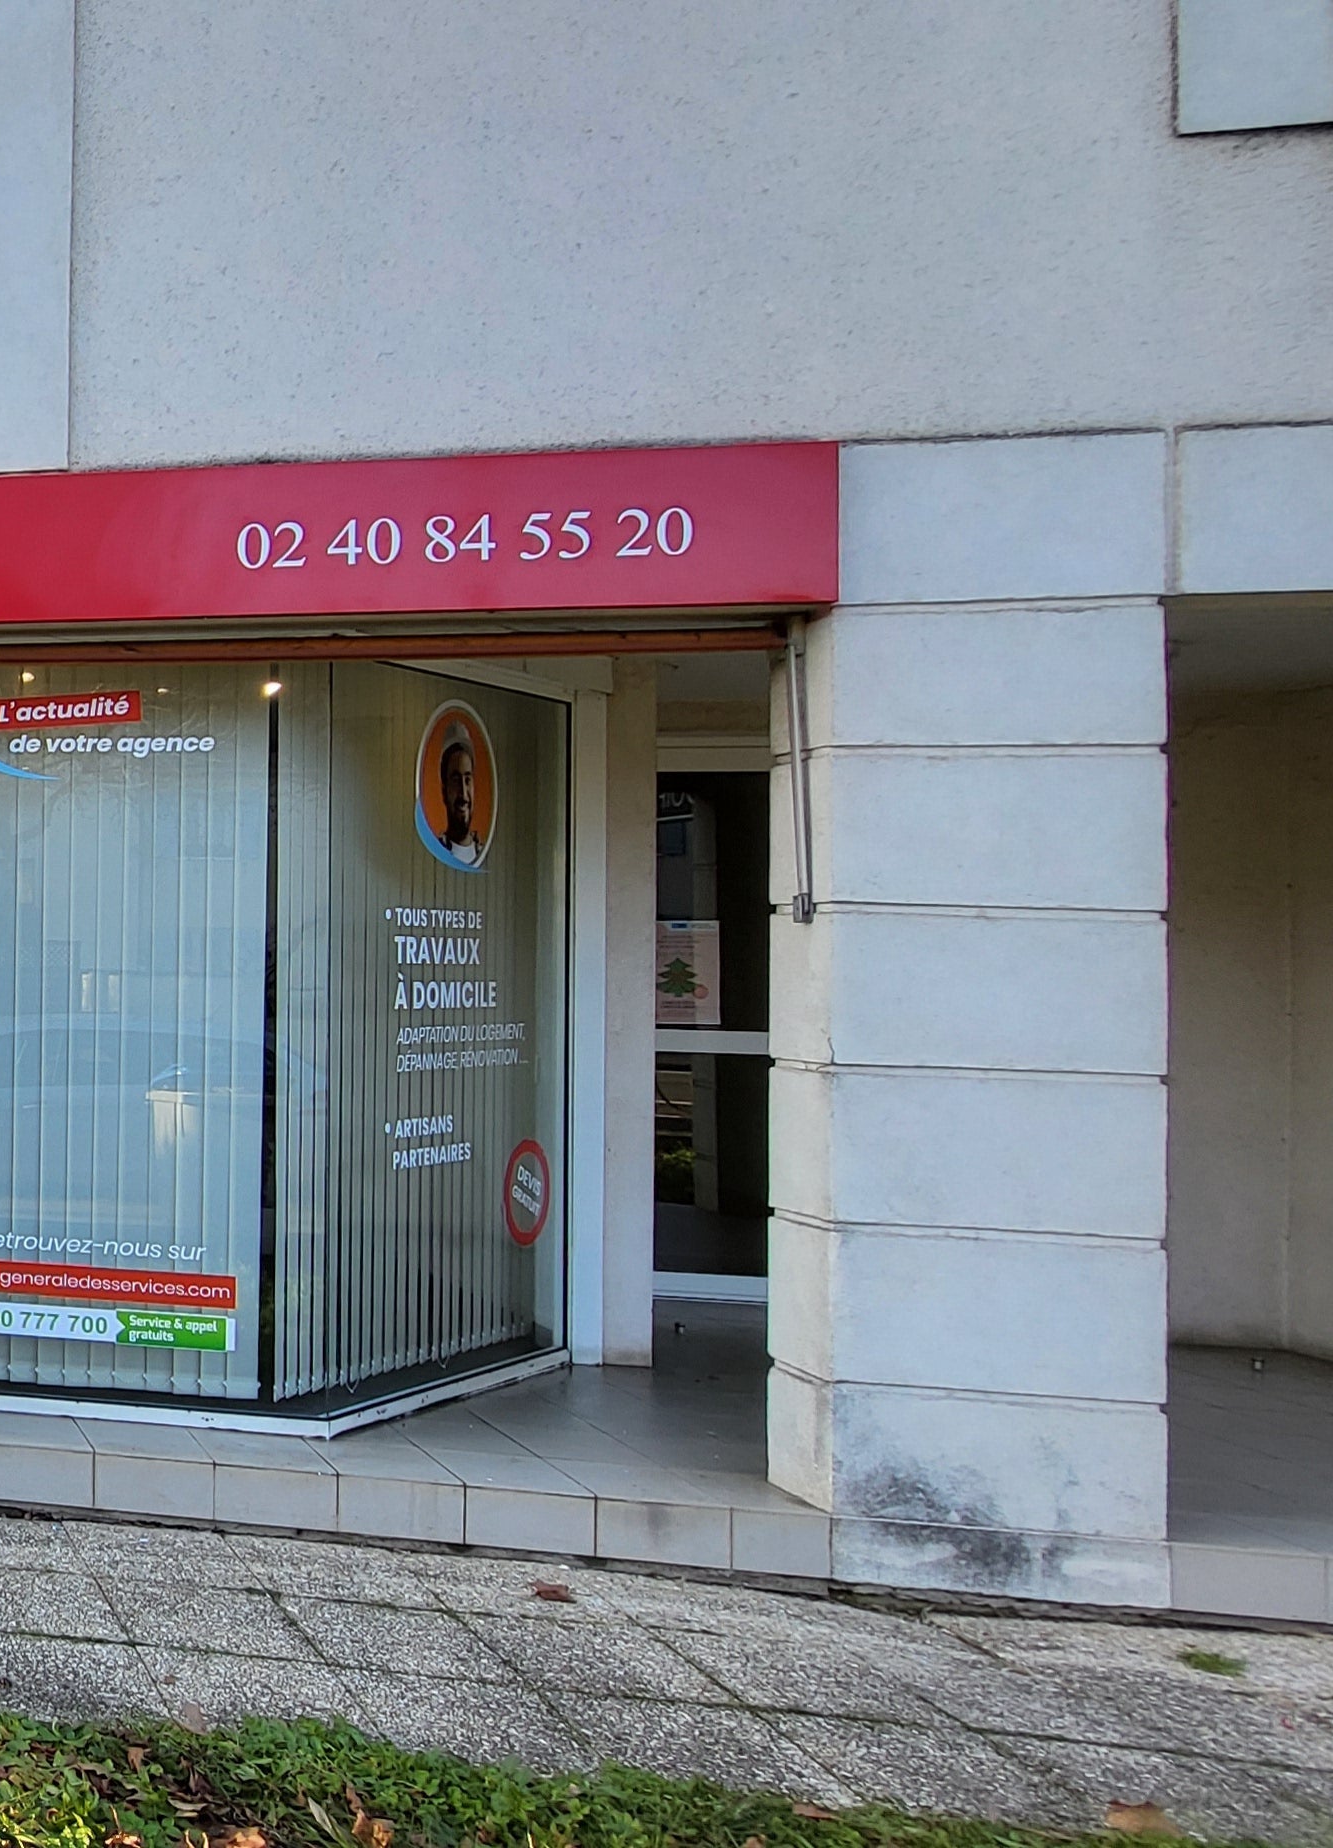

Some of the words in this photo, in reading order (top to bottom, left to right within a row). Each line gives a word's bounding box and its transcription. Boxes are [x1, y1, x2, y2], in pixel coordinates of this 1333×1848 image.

[236, 520, 307, 568] 02
[326, 517, 402, 566] 40
[424, 513, 496, 563] 84
[518, 511, 591, 561] 55
[615, 506, 694, 557] 20
[9, 735, 41, 753] de
[45, 737, 113, 753] votre
[116, 735, 215, 758] agence
[395, 907, 427, 928] TOUS
[430, 909, 465, 929] TYPES
[467, 911, 483, 929] DE
[395, 935, 481, 965] TRAVAUX
[394, 972, 408, 1011] À
[413, 981, 497, 1010] DOMICILE
[396, 1026, 458, 1045] ADAPTATION
[460, 1025, 473, 1042] DU
[395, 1114, 453, 1139] ARTISANS
[393, 1142, 471, 1171] PARTENAIRES
[517, 1164, 542, 1197] DEVIS
[512, 1185, 541, 1217] GRATUIT
[168, 1246, 206, 1261] sur
[19, 1311, 59, 1331] 777
[68, 1315, 108, 1334] 700
[129, 1315, 172, 1329] Service
[174, 1317, 183, 1330] &
[185, 1319, 218, 1335] appel
[129, 1329, 174, 1343] gratuits
